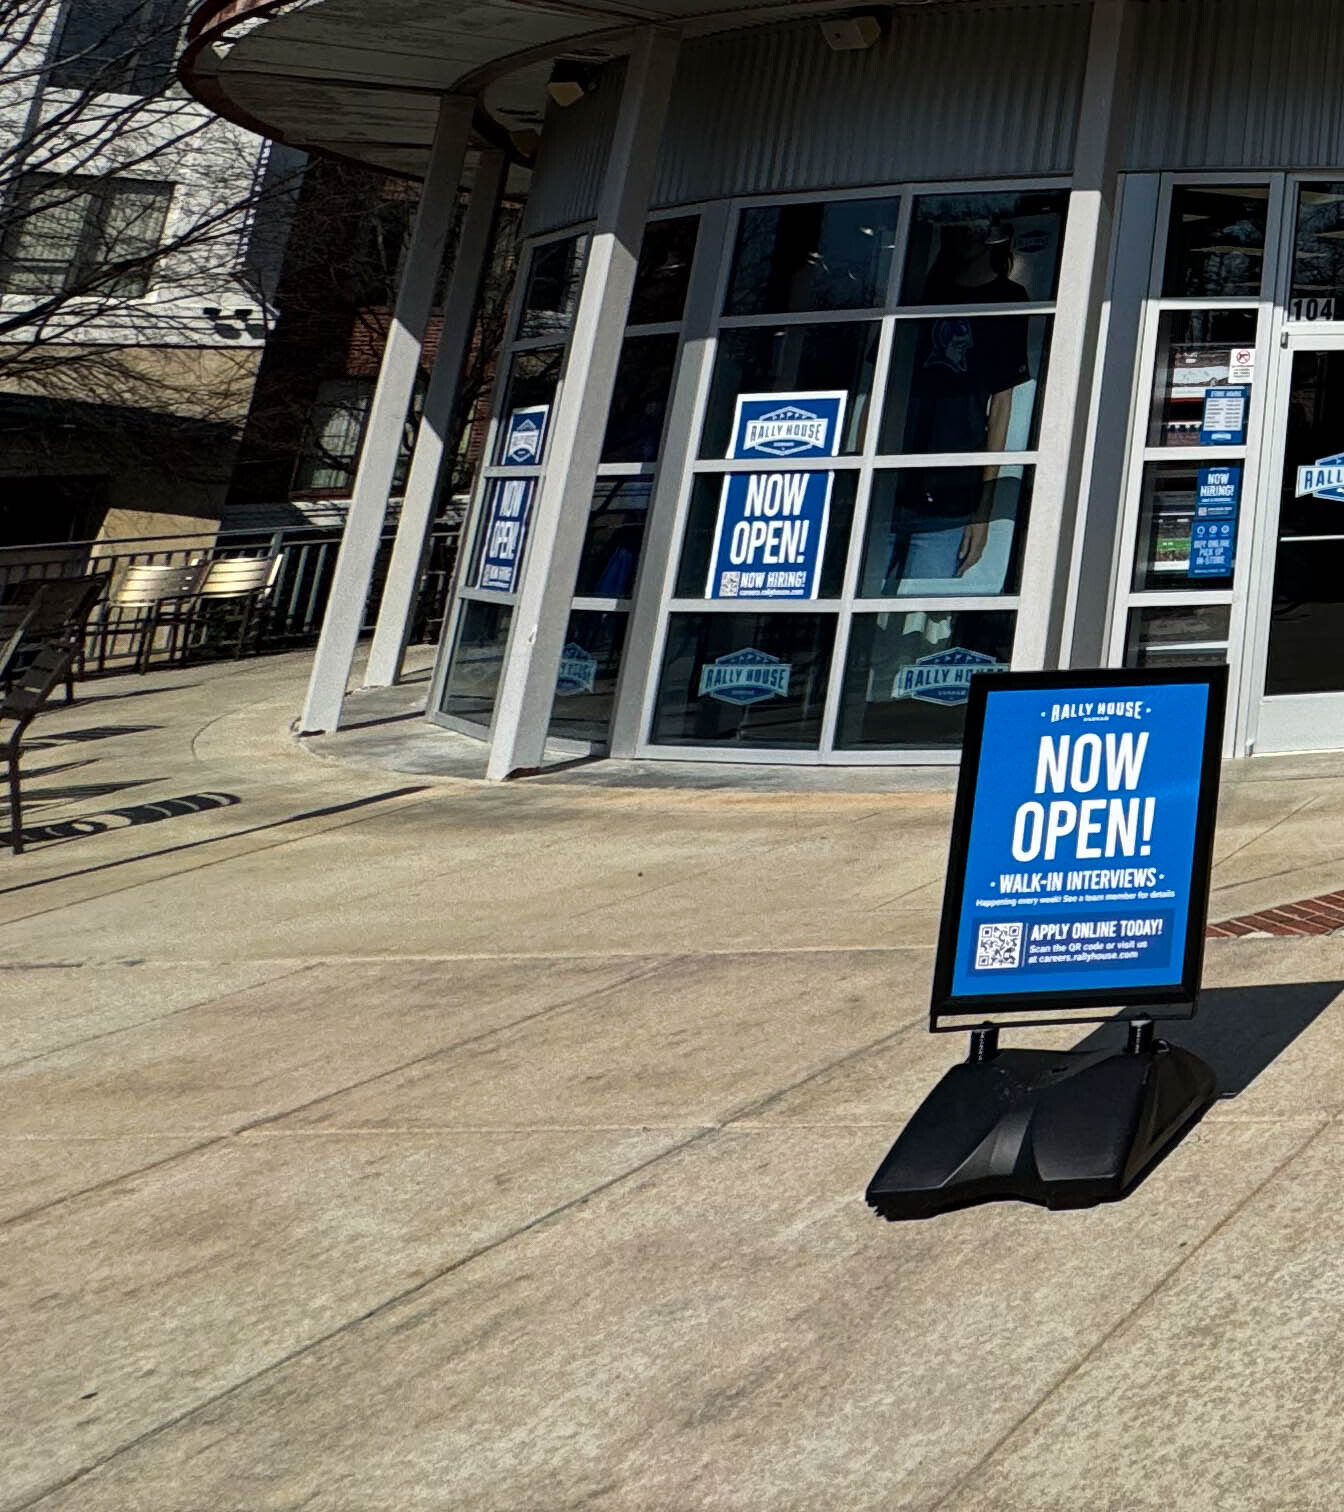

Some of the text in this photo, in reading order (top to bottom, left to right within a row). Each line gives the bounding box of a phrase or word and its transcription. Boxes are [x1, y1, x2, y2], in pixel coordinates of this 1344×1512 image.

[1294, 299, 1332, 321] 104
[750, 423, 822, 442] RALLY HOUSE
[744, 473, 810, 517] NOW
[730, 520, 809, 565] OPEN!
[740, 571, 807, 588] NOW HIRING!
[706, 667, 786, 689] RALLY HOUSE
[904, 669, 949, 691] RALLY
[1051, 701, 1143, 723] RALLY HOUSE
[1034, 731, 1150, 794] NOW
[1011, 797, 1157, 863] OPEN!
[1000, 868, 1157, 894] WALK-IN INTERVIEWS
[1030, 918, 1163, 941] APPLY ONLINE TODAY!
[1028, 951, 1139, 963] at careers.rallyhouse.com
[1029, 944, 1051, 954] Scan
[1052, 943, 1066, 953] the
[1068, 942, 1082, 952] QR
[1083, 941, 1105, 951] code
[1117, 940, 1135, 949] visit
